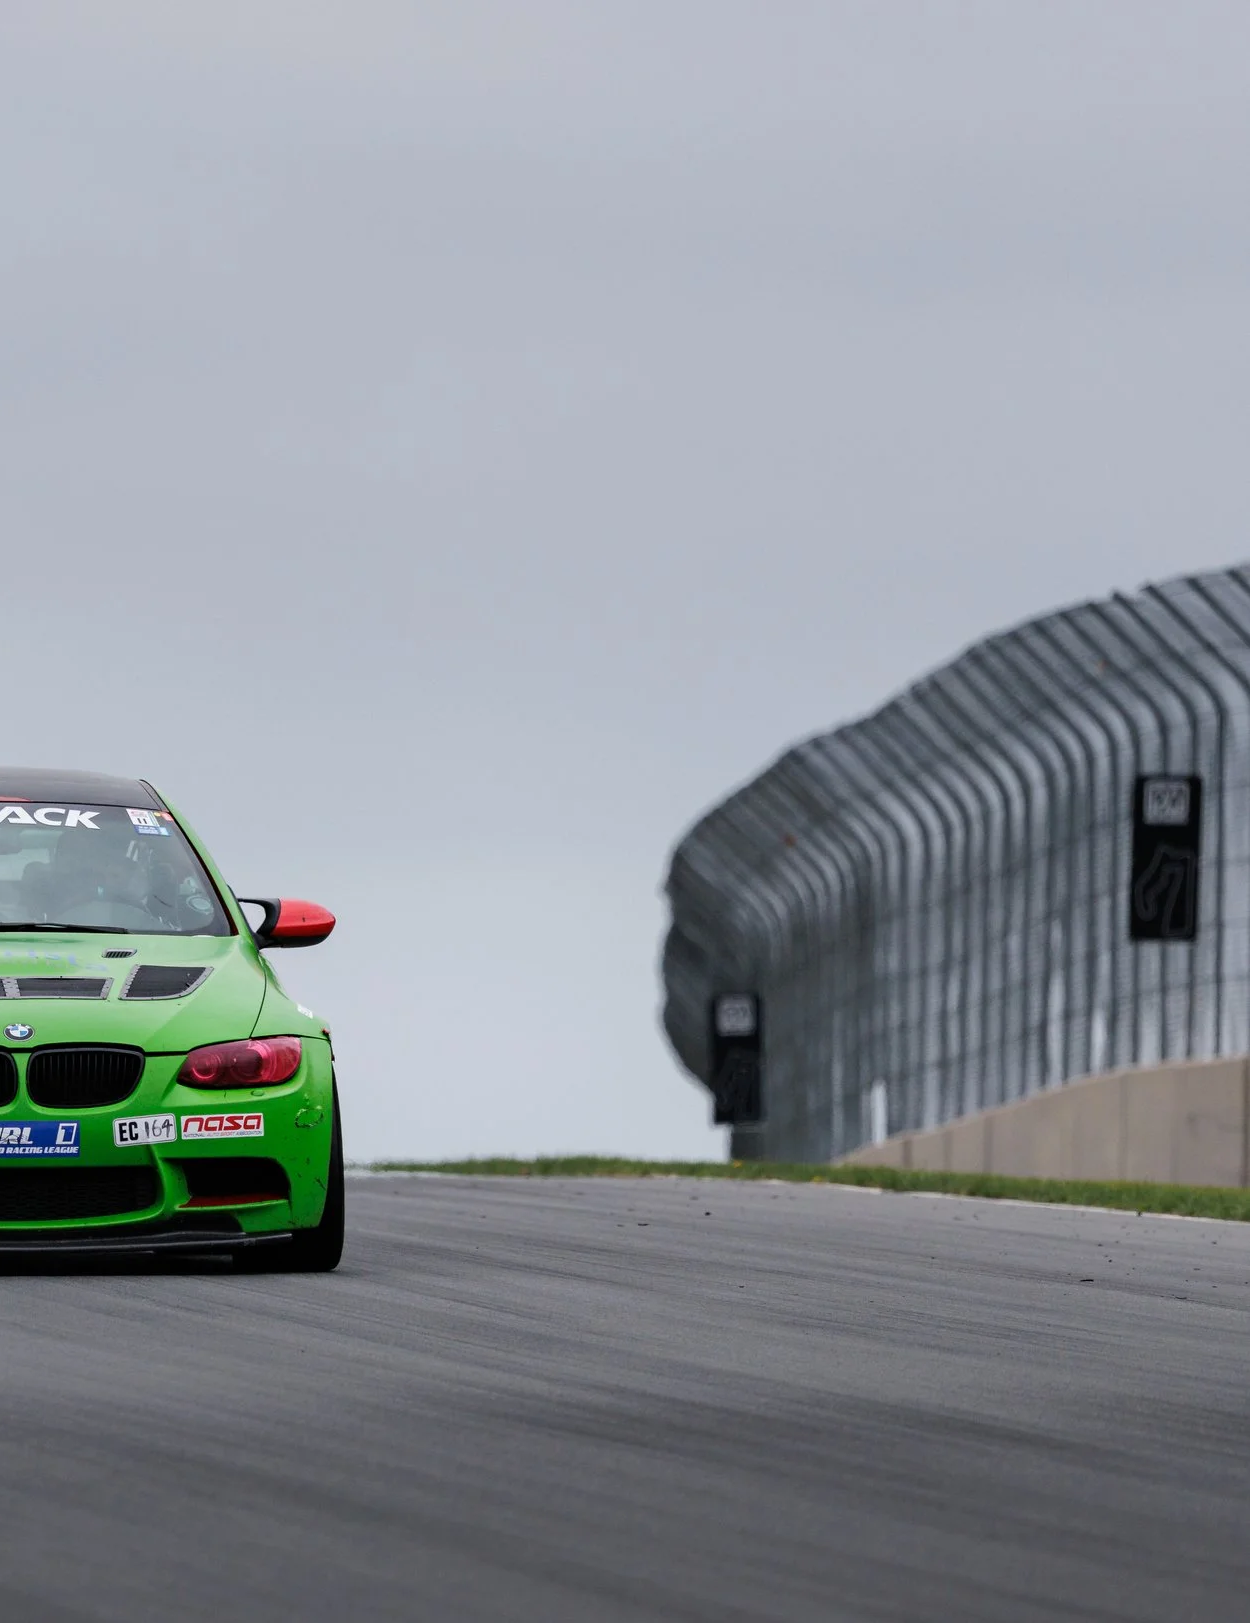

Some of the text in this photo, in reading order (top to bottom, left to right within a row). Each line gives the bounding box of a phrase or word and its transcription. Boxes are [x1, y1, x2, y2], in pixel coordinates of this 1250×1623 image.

[118, 1121, 139, 1142] EC
[144, 1119, 173, 1139] 164
[6, 1146, 43, 1154] RACING
[44, 1146, 79, 1154] LEAGUE
